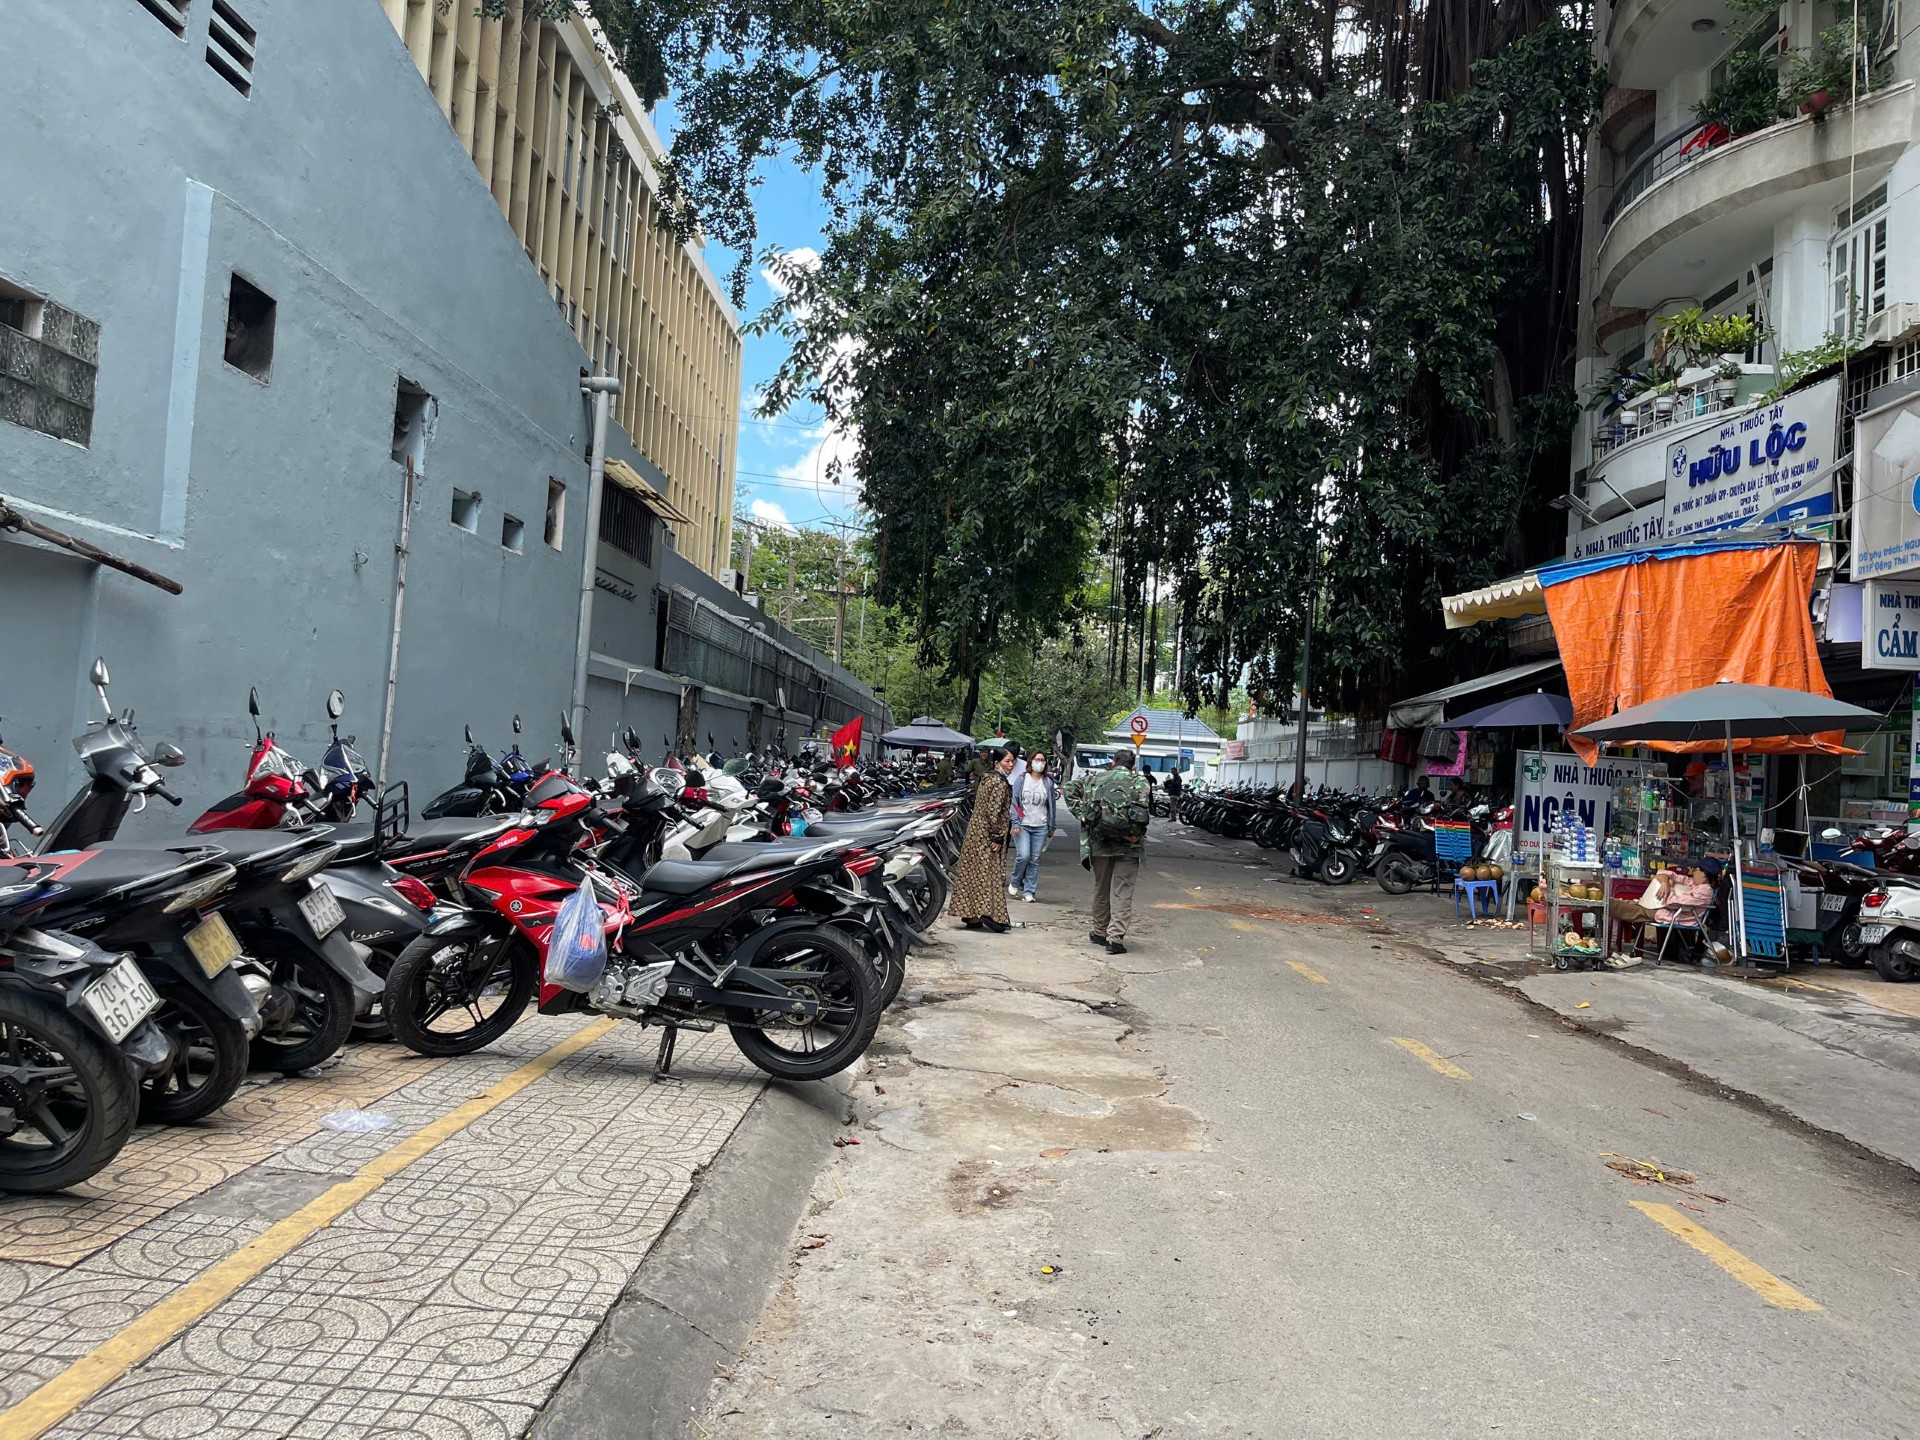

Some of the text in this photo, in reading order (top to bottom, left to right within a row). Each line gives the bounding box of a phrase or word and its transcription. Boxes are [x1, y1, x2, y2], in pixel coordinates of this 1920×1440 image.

[1720, 405, 1784, 441] NHÀ THUỐC TÂY
[1688, 421, 1808, 488] HỮU LỘC
[1585, 516, 1663, 557] NHÀ THUỐC TÂY
[1869, 550, 1882, 561] phụ
[1880, 591, 1901, 608] NHÀ
[1878, 613, 1918, 658] CẨM
[1553, 762, 1579, 784] NHÀ
[1583, 762, 1622, 786] THUỐC
[1523, 791, 1596, 834] NGÂN
[497, 836, 518, 848] YAMAHA
[93, 965, 134, 1011] 70-K1
[105, 982, 153, 1036] 367.50
